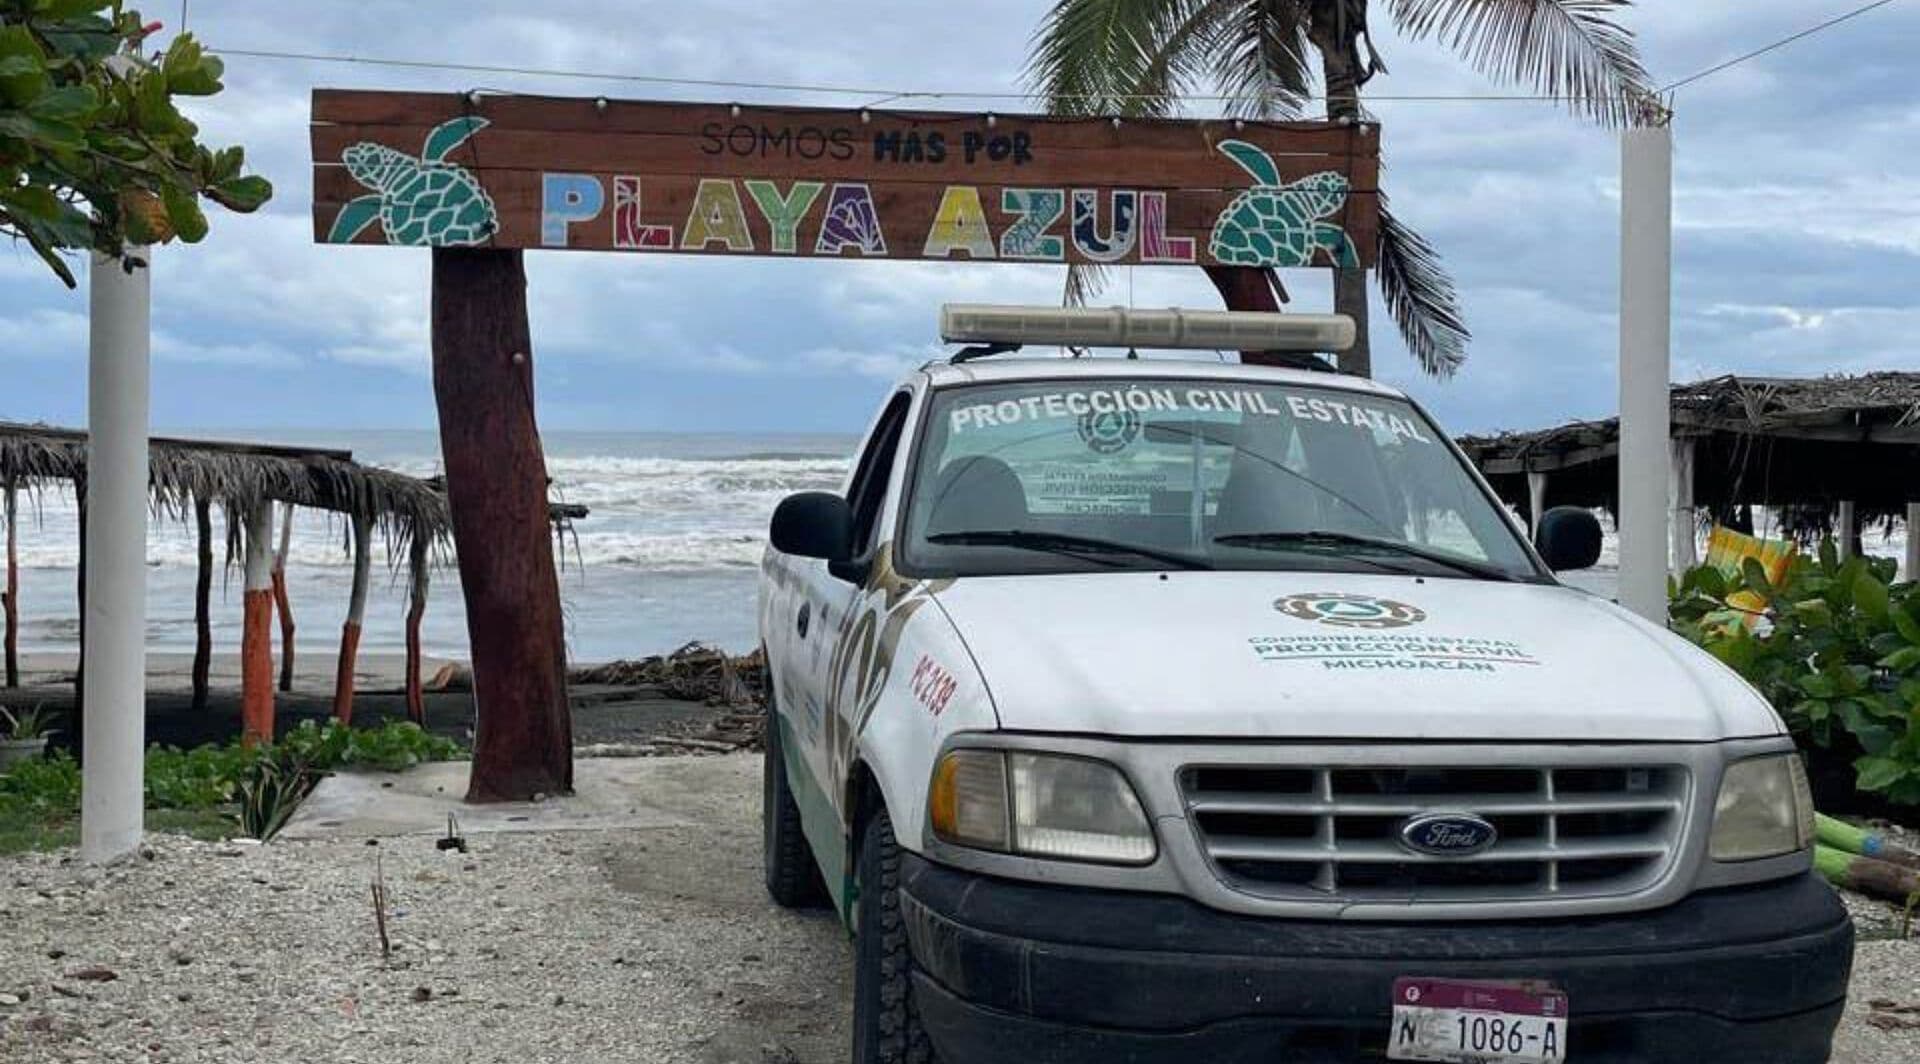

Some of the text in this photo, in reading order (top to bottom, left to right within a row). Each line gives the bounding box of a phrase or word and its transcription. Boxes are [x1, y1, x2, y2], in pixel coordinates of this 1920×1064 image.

[701, 121, 1033, 165] SOMOS MÁS POR
[541, 173, 1197, 263] PLAYA AZUL
[951, 384, 1432, 444] PROTECCIÓN CIVIL ESTATAL
[1456, 645, 1535, 658] CIVIL
[1425, 822, 1478, 847] Ford
